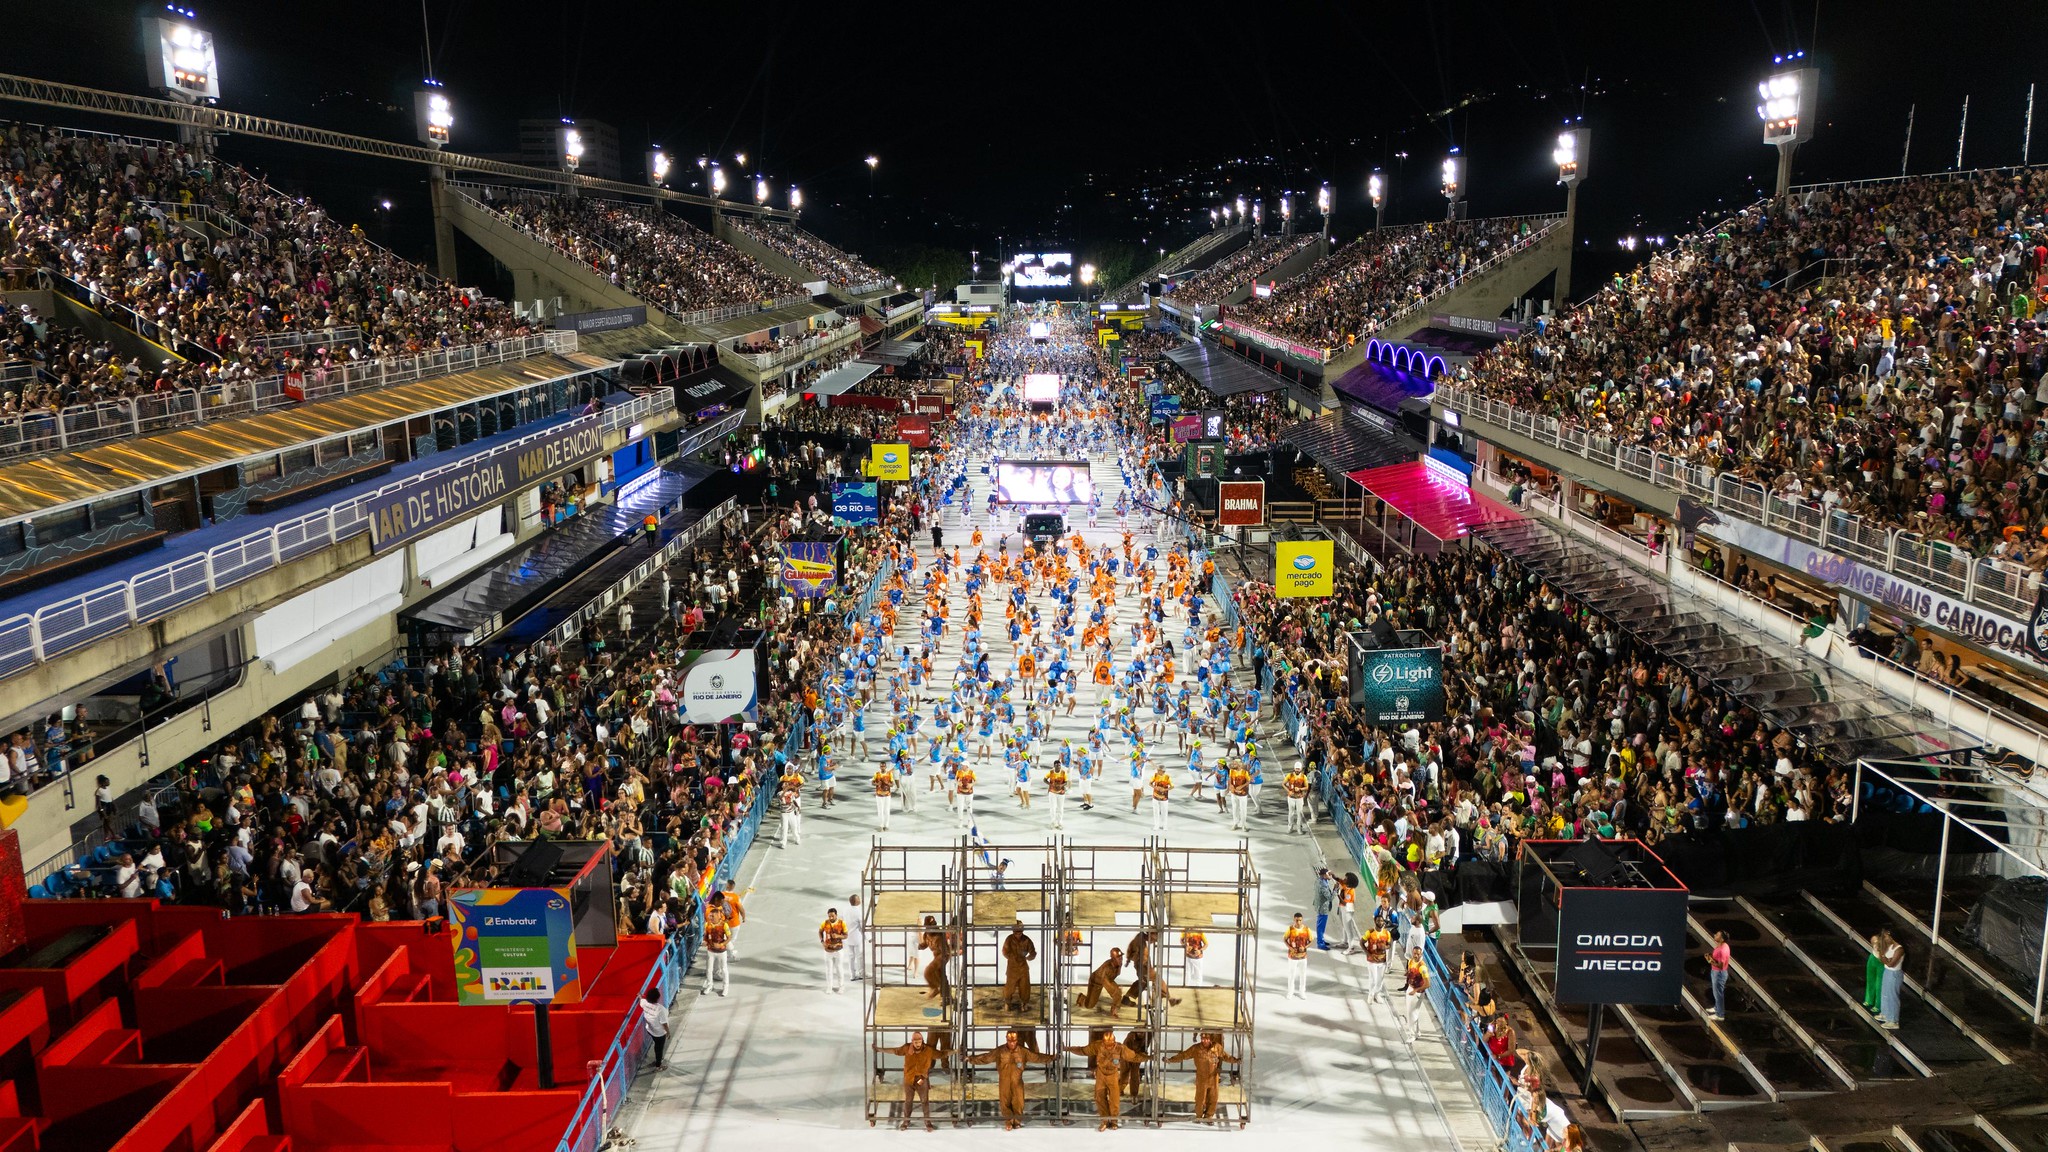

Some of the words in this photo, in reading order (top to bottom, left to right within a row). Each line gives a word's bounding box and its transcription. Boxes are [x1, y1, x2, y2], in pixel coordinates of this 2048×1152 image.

[1481, 320, 1496, 333] FAVELA
[408, 490, 433, 528] DE
[435, 464, 506, 517] HISTÓRIA
[517, 447, 545, 481] MAR
[546, 443, 562, 468] DE
[1225, 499, 1258, 510] BRAHMA
[1806, 550, 1818, 571] O
[1821, 555, 1888, 598] LOUNGE
[1888, 580, 1932, 618] MAIS
[1936, 600, 2026, 658] CARIOCA
[1396, 666, 1433, 682] Light
[495, 917, 537, 926] Embratur
[1576, 935, 1663, 946] OMODA
[1574, 960, 1661, 971] JAECOO
[490, 977, 547, 990] BRASIL
